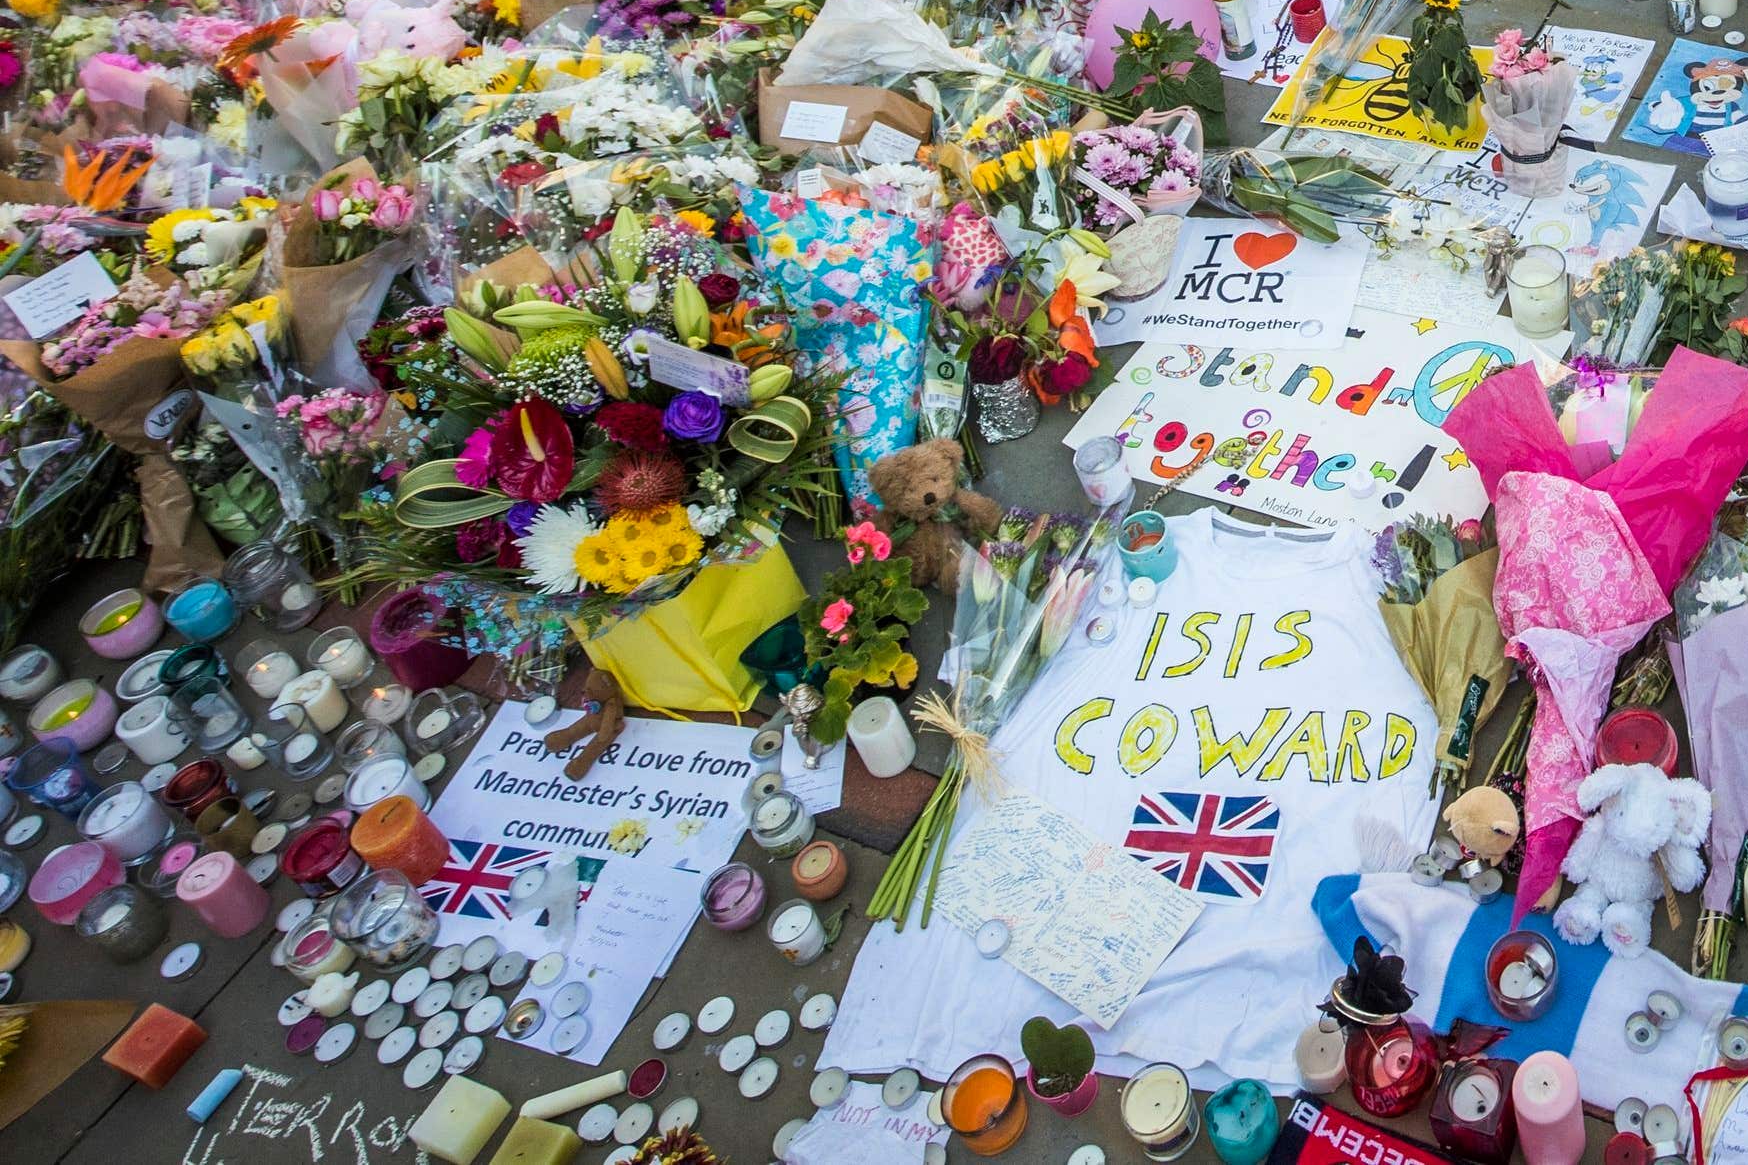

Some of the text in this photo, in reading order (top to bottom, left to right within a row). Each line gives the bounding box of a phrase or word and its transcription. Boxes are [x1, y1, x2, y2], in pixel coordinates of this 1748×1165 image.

[1269, 111, 1316, 125] NEER
[1454, 136, 1480, 150] KID
[1439, 164, 1510, 201] MCR
[1192, 234, 1233, 270] I
[1174, 271, 1286, 304] MCR
[1142, 314, 1302, 332] #WeStandTogether
[1260, 495, 1304, 519] Moston
[1135, 609, 1314, 682] ISIS
[1052, 696, 1418, 786] COWARD
[624, 745, 684, 772] Love
[687, 750, 752, 779] from
[648, 789, 730, 819] Syrian
[832, 1102, 881, 1124] NOT
[884, 1117, 909, 1135] IN
